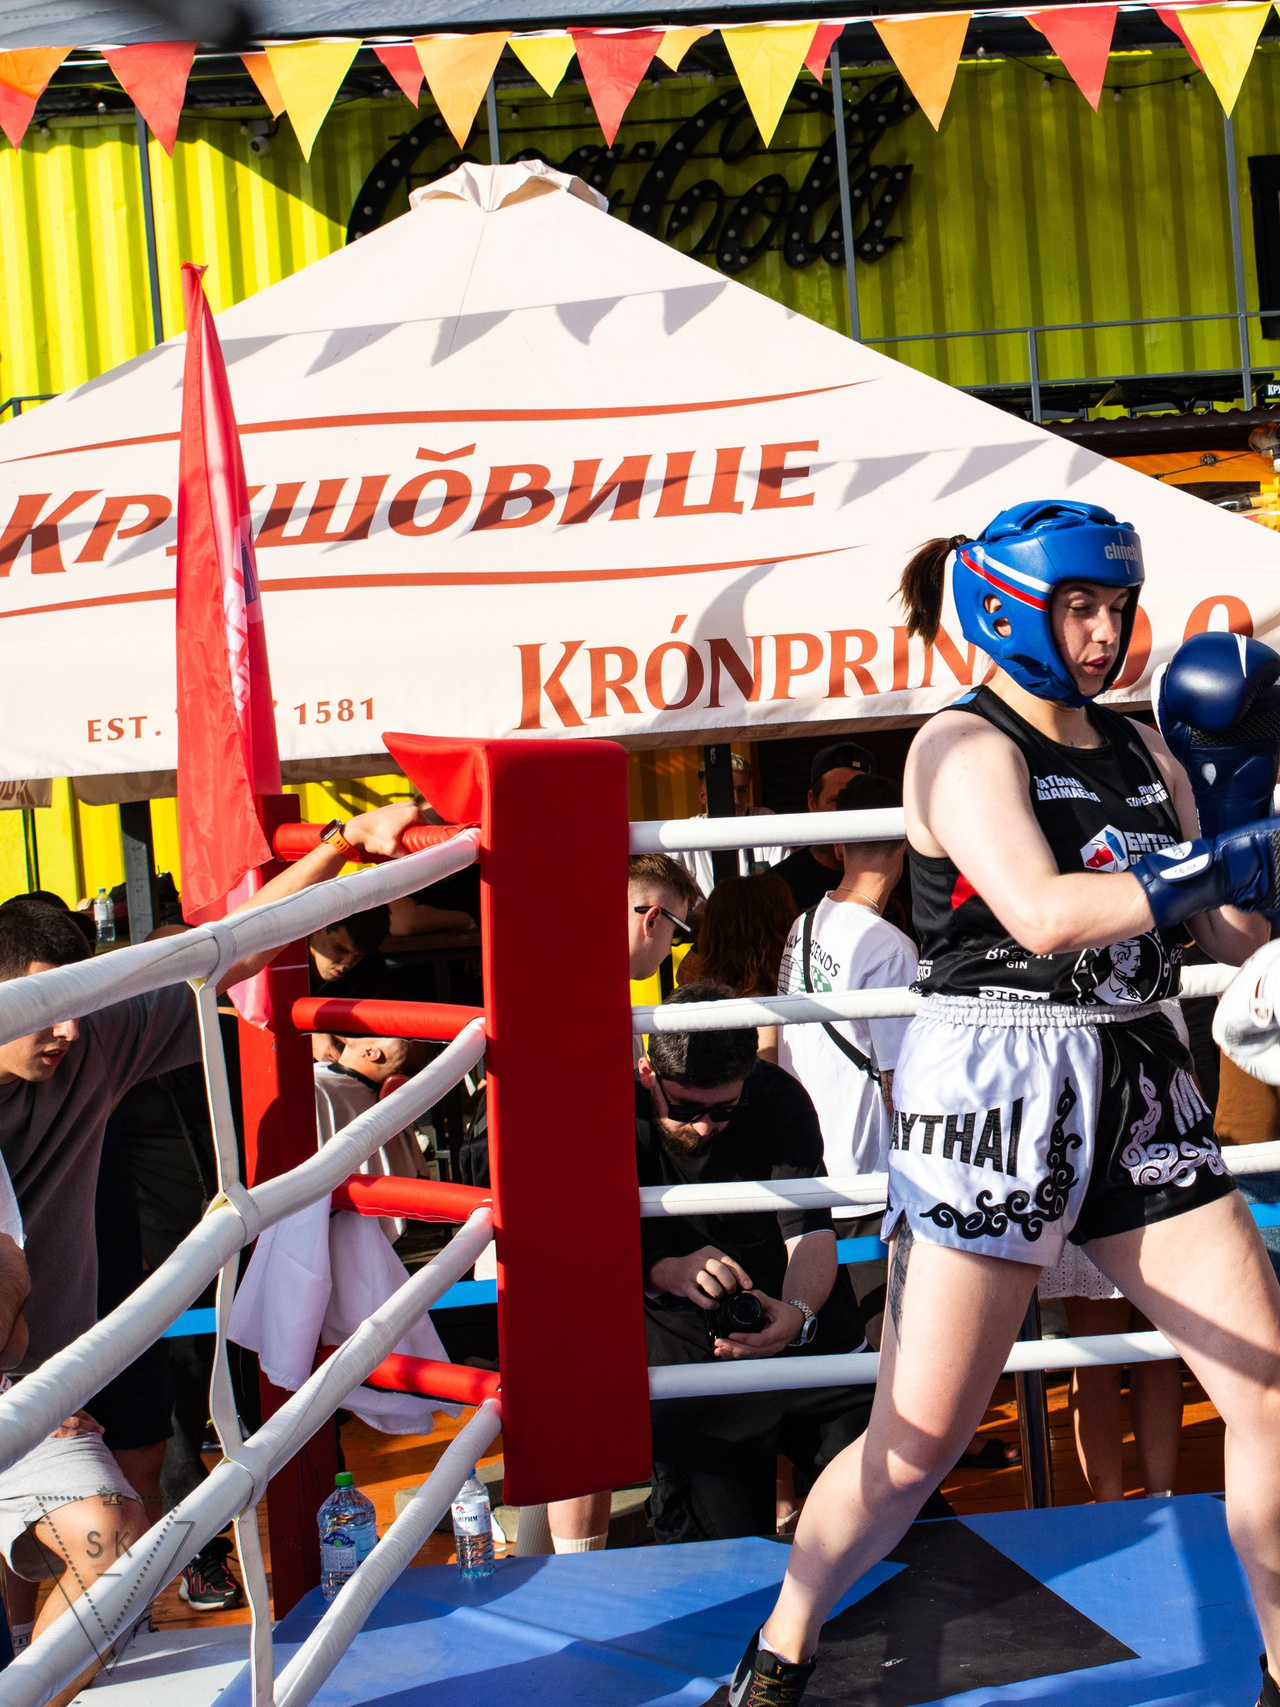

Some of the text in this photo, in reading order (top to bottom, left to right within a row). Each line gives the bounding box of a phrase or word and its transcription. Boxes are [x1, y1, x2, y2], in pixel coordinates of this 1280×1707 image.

[0, 440, 820, 577] КРШО̌ВИЦЕ
[515, 615, 990, 732] KRÓNPRIN
[87, 697, 375, 743] EST. 1581
[1006, 960, 1028, 969] GIN
